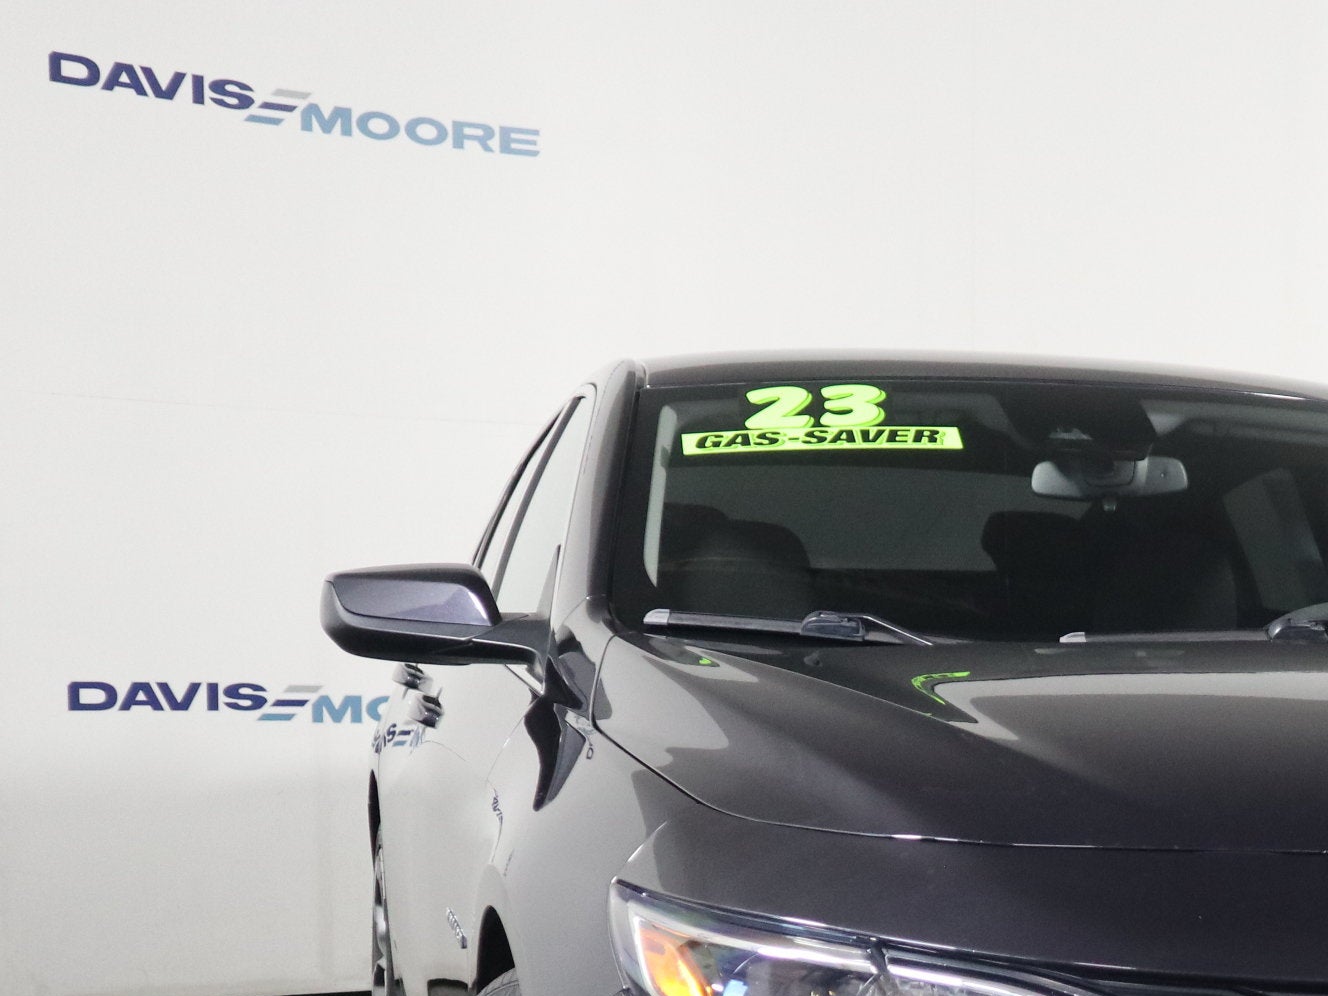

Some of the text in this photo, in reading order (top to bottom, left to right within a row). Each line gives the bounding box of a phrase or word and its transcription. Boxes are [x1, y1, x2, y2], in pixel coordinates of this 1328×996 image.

[48, 51, 540, 158] DAVIS MOORE
[744, 384, 887, 430] 23
[695, 428, 944, 450] GAS-SAVER
[67, 681, 268, 712] DAVIS
